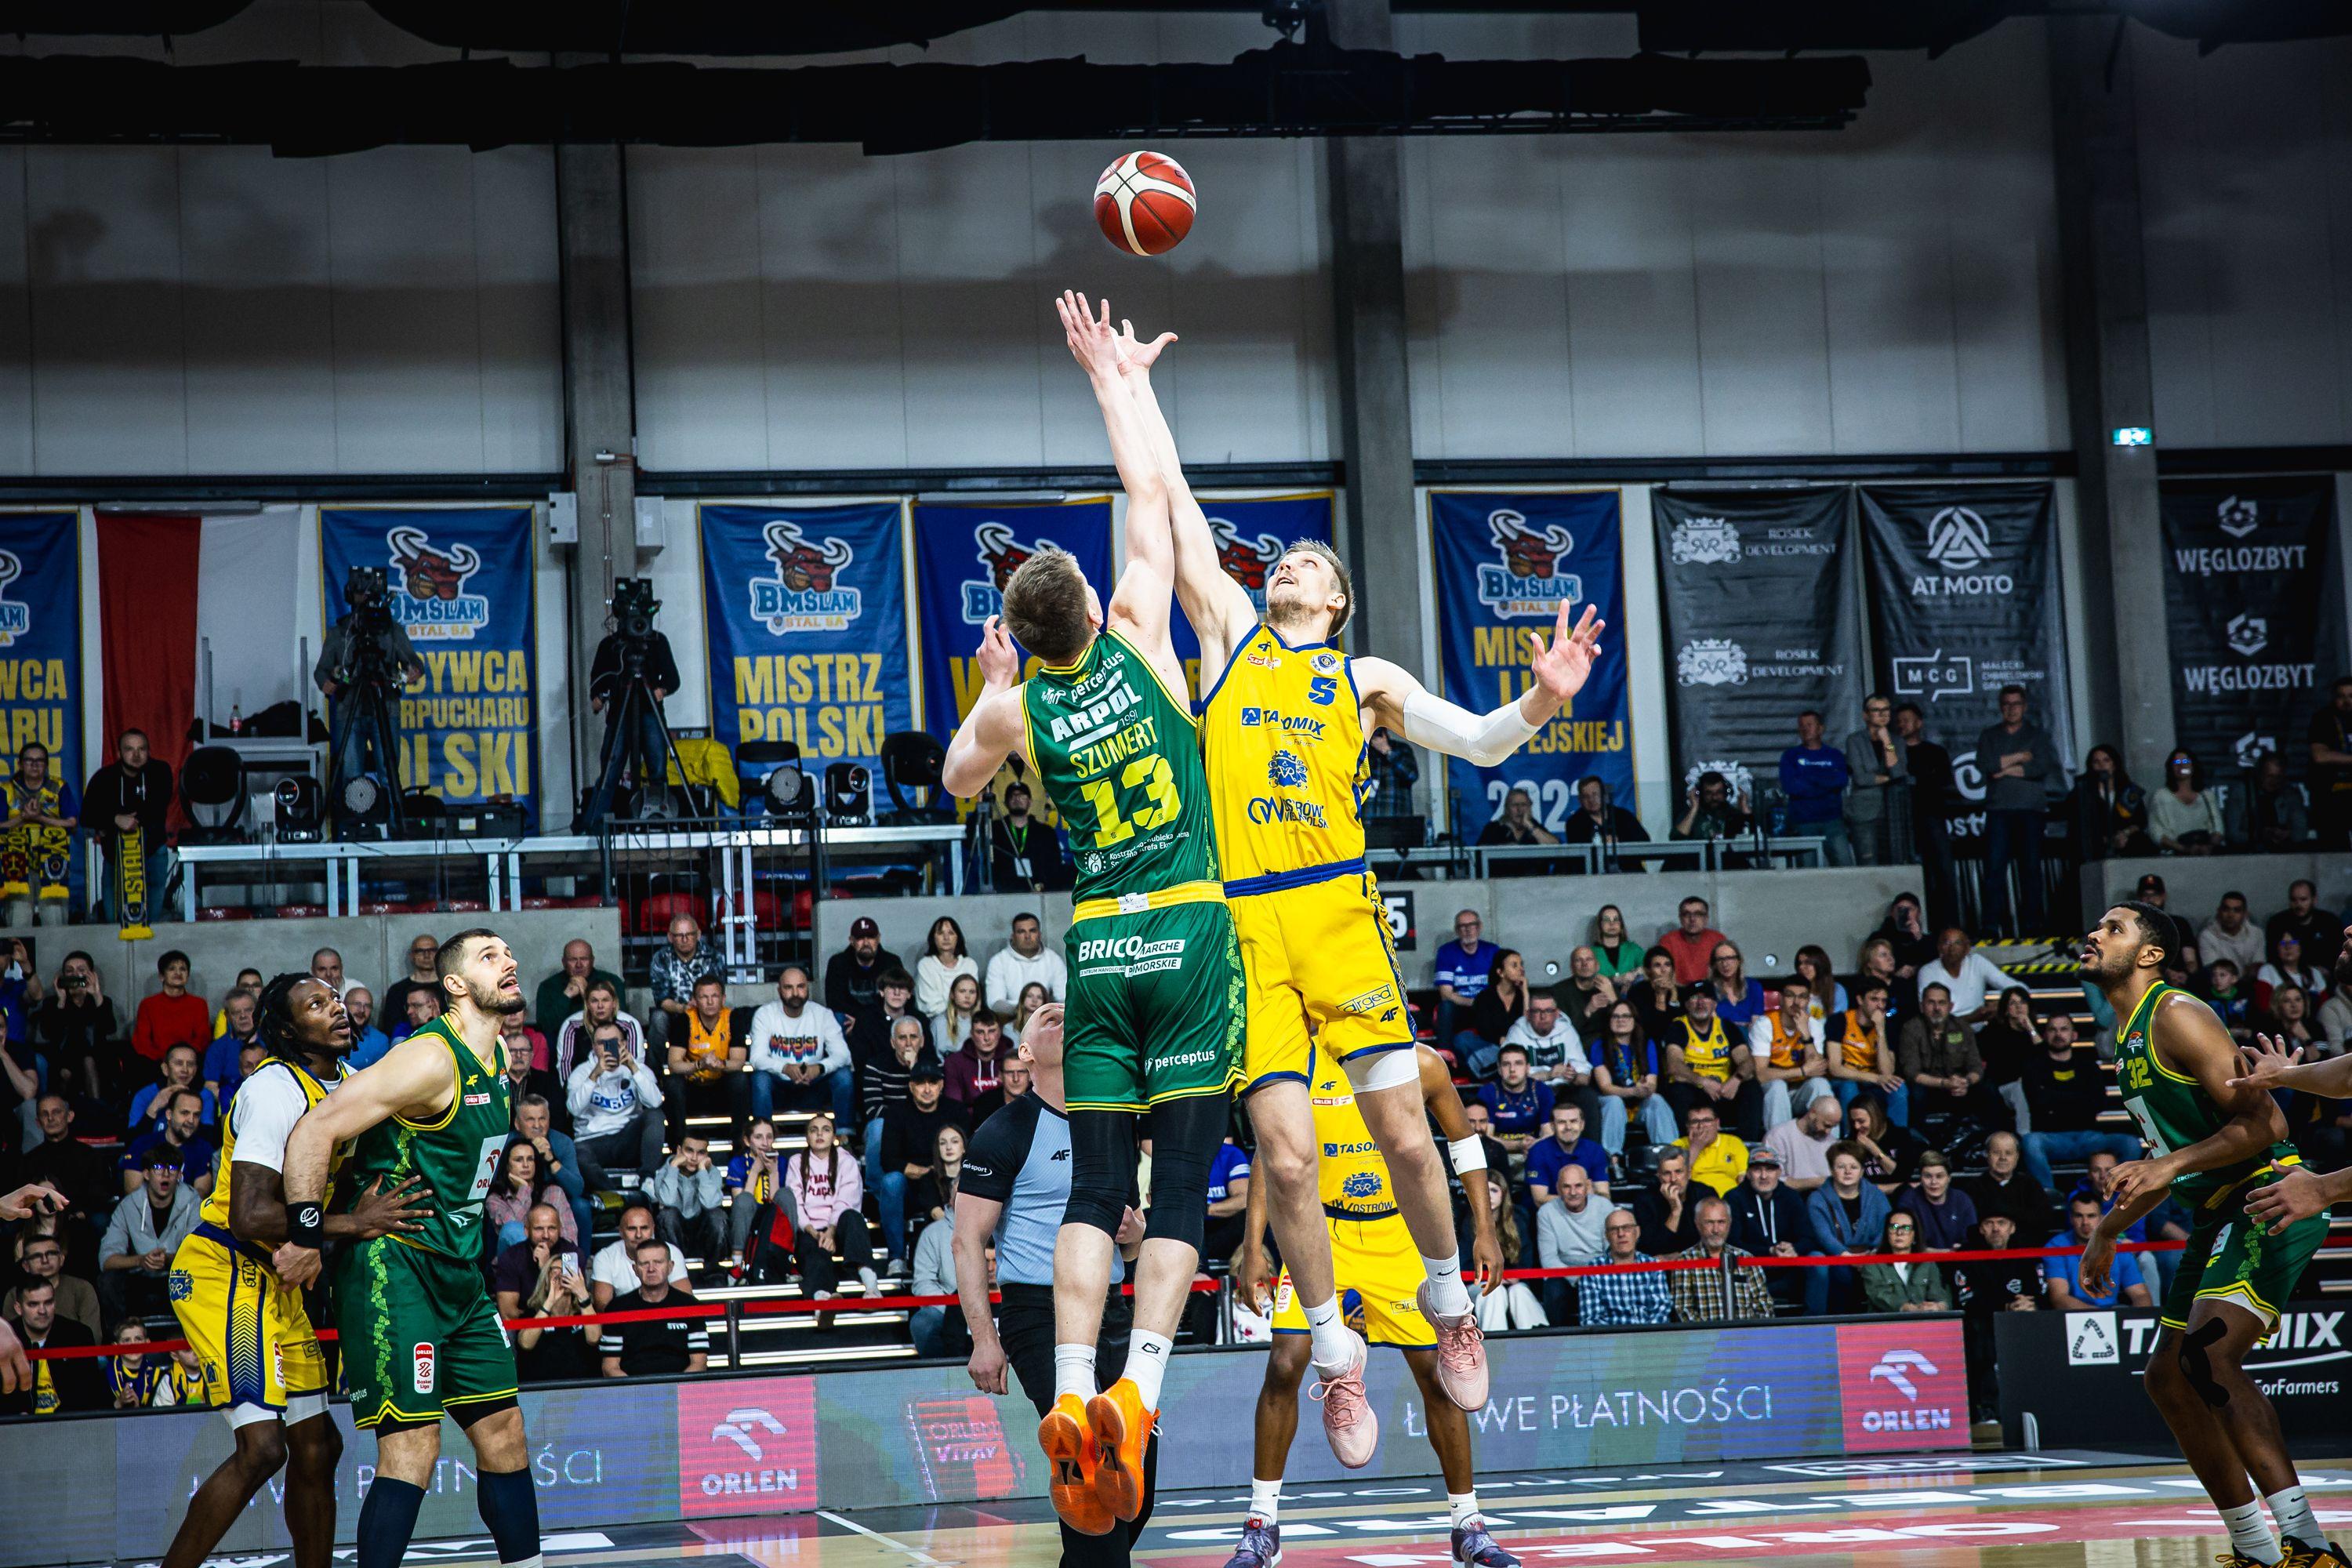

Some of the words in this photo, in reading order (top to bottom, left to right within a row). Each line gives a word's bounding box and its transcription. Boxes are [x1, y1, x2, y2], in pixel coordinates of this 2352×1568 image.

[1745, 543, 1837, 557] DEVELOPMENT
[2176, 546, 2307, 576] WĘGLOZBYT
[1483, 570, 1579, 599] BMSLAM
[1911, 576, 1939, 596] AT
[1944, 575, 2013, 595] MOTO
[757, 586, 857, 614] BMSLAM
[785, 616, 820, 628] STAL
[735, 654, 884, 705] MISTRZ
[1752, 664, 1843, 678] DEVELOPMENT
[2183, 664, 2315, 695] WĘGLOZBYT
[1308, 677, 1338, 706] 5
[401, 697, 530, 729] RPUCHARU
[1050, 683, 1142, 742] ARPOL
[1264, 710, 1326, 735] TAOMIX
[739, 705, 885, 759] POLSKI
[1069, 716, 1160, 779] SZUMERT
[1080, 753, 1182, 848] 13
[1155, 1049, 1215, 1072] perceptus
[2126, 1058, 2154, 1089] 32
[1340, 1141, 1379, 1155] TASO
[350, 1388, 368, 1403] ceptus
[1552, 1378, 1773, 1431] PŁATNOŚCI
[1862, 1408, 1952, 1432] ORLEN
[701, 1468, 797, 1496] ORLEN
[1342, 1522, 2062, 1567] ORLEN
